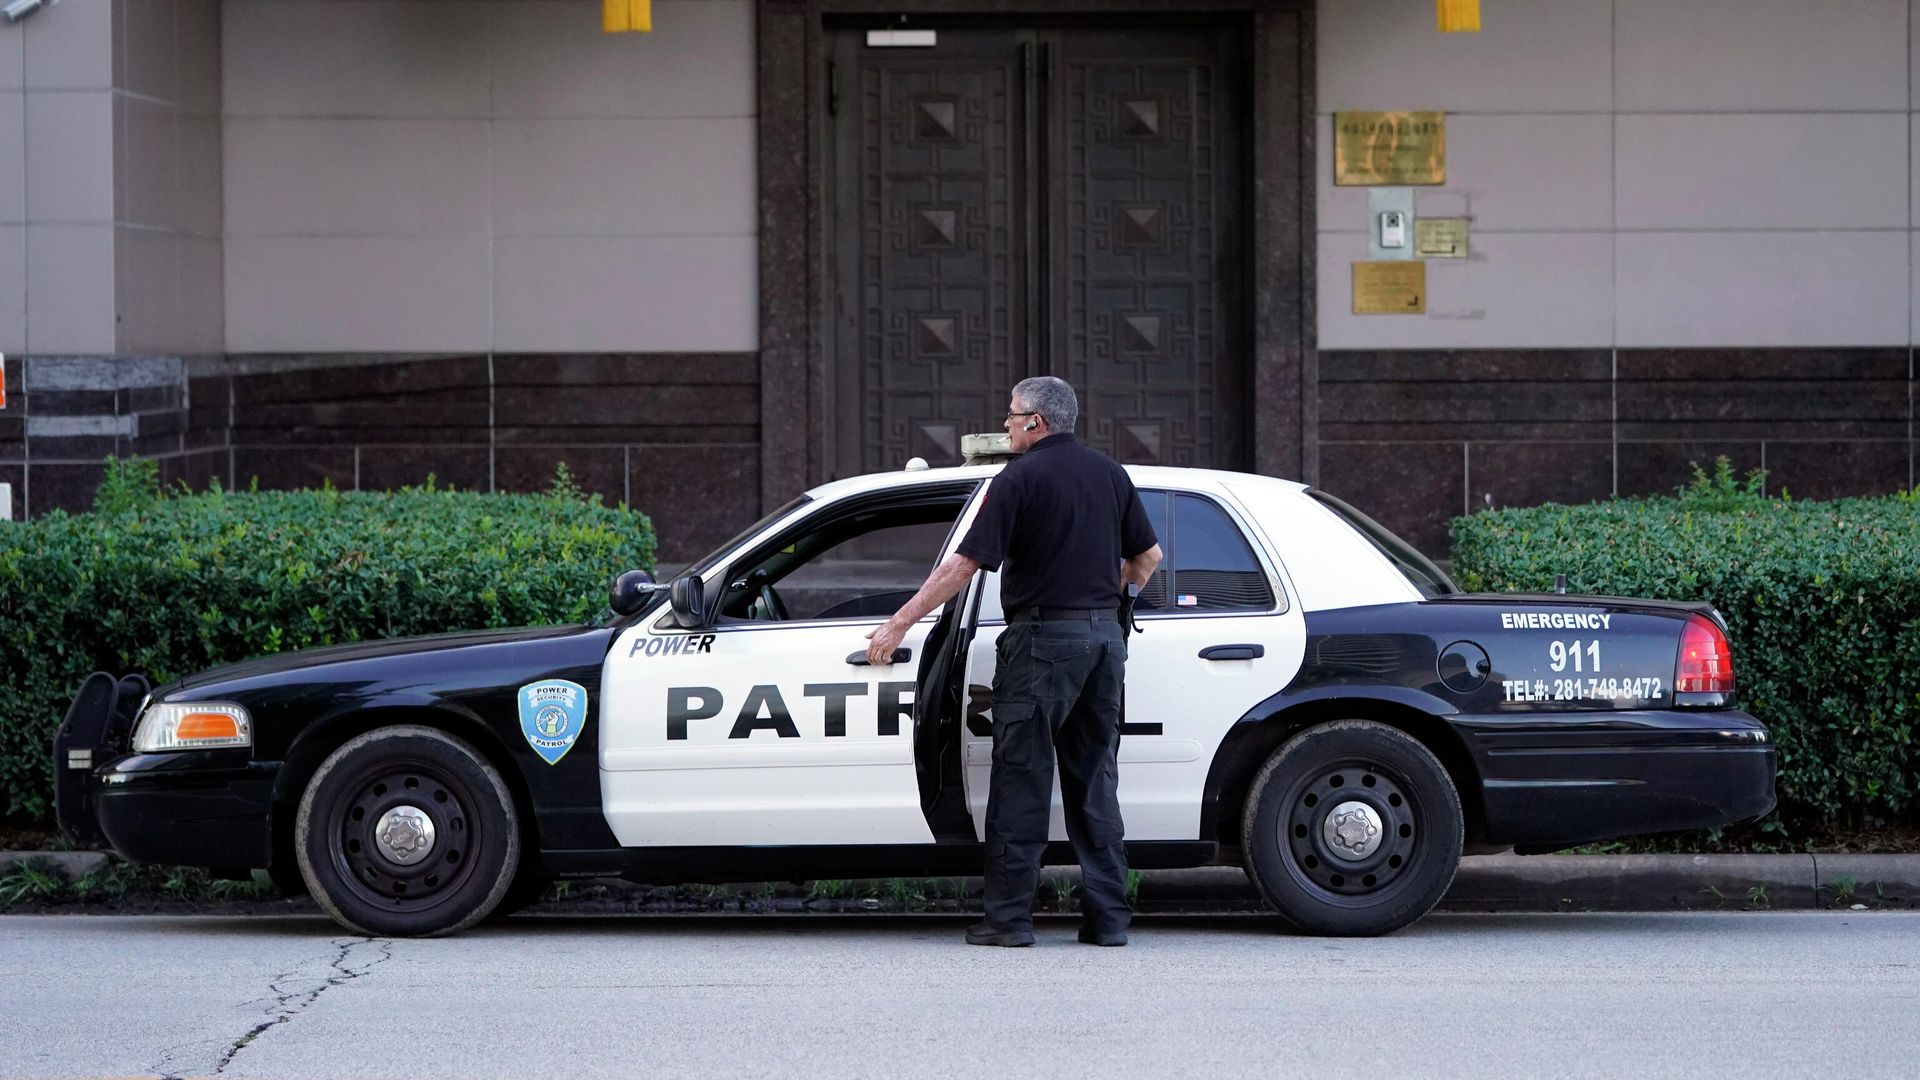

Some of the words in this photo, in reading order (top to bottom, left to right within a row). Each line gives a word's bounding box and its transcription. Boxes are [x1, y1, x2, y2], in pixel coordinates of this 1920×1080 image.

[1501, 613, 1611, 629] EMERGENCY
[628, 634, 716, 658] POWER
[1550, 640, 1601, 672] 911
[1502, 679, 1549, 701] TEL#:
[1554, 677, 1662, 700] 281-748-8472
[536, 739, 567, 747] PATROL
